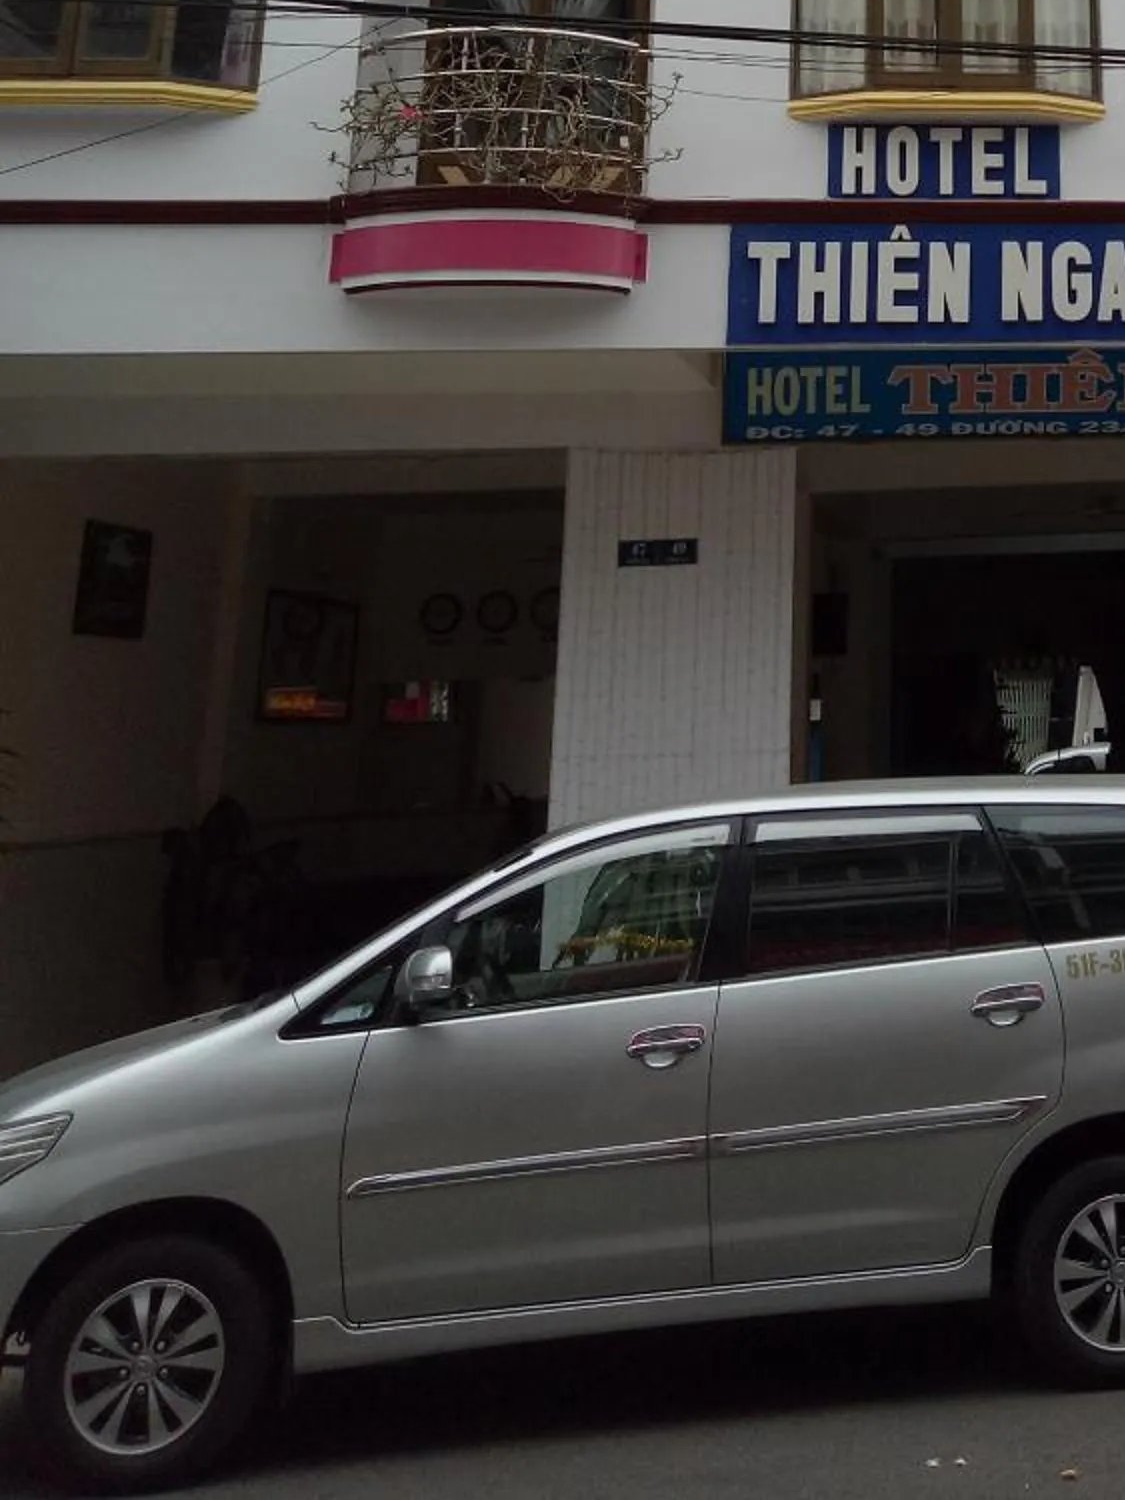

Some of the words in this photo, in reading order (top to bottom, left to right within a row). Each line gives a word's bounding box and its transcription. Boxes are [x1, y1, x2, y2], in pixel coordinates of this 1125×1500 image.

[841, 126, 1048, 195] HOTEL
[747, 225, 971, 323] THIÊN
[747, 366, 871, 415] HOTEL
[815, 422, 861, 438] 47
[895, 422, 940, 437] 49
